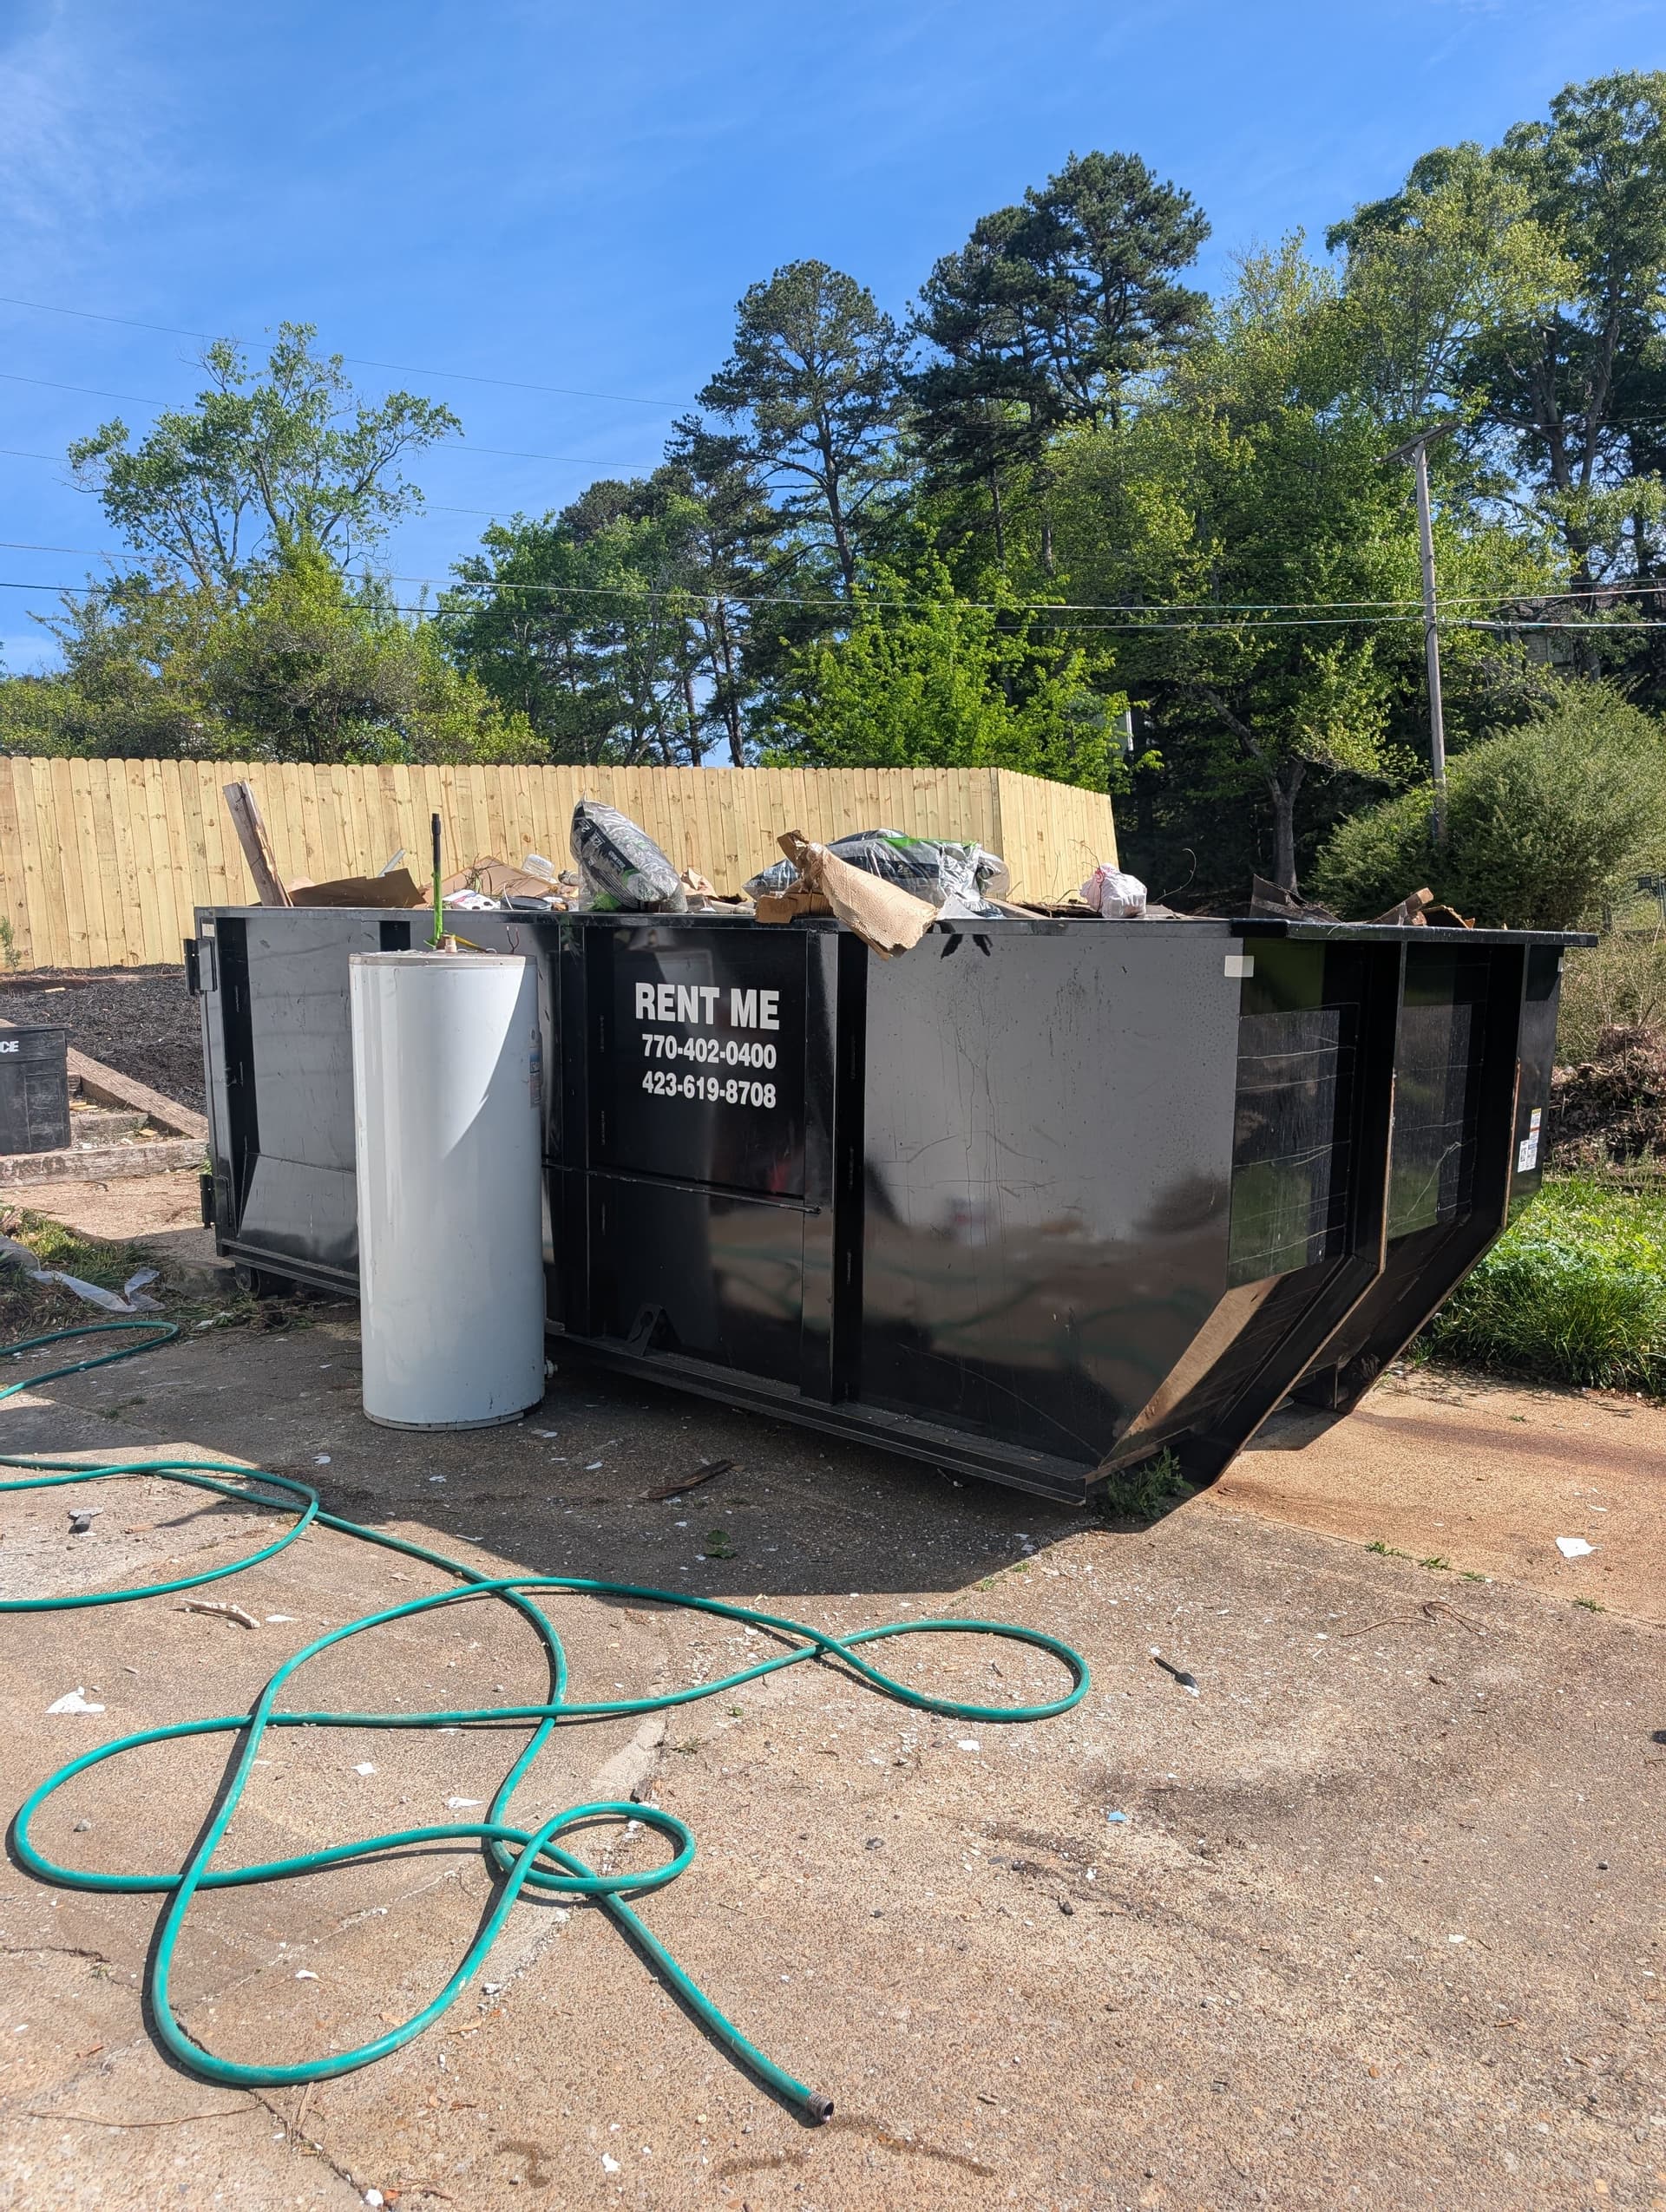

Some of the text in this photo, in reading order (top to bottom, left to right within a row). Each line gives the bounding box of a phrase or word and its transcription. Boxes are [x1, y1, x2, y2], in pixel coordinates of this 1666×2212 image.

[635, 982, 780, 1031] RENT ME
[641, 1033, 777, 1070] 770-402-0400
[641, 1070, 777, 1109] 423-619-8708
